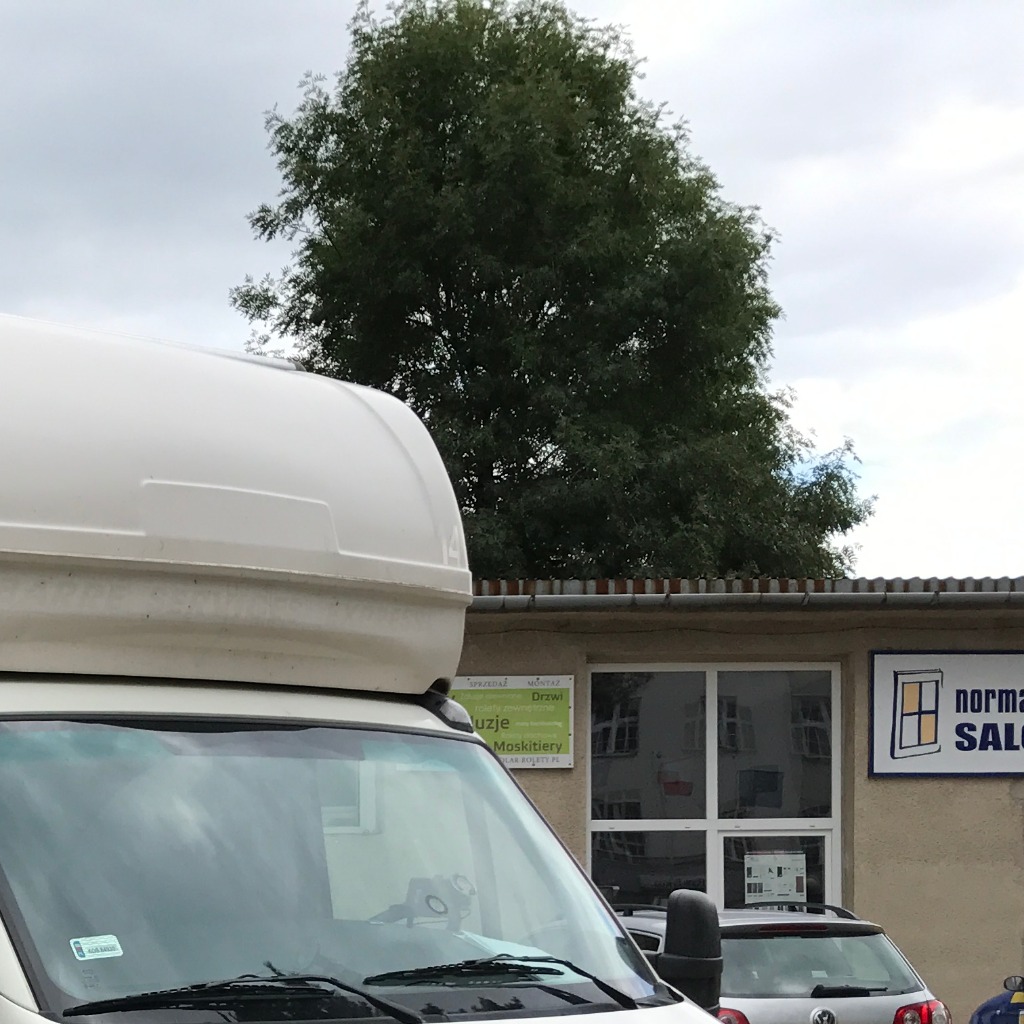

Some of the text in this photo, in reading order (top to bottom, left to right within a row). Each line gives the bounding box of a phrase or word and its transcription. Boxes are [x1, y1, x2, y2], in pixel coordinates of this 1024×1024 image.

[532, 691, 563, 701] Drzwi
[955, 722, 1024, 751] SAL
[493, 740, 563, 752] Moskitiery
